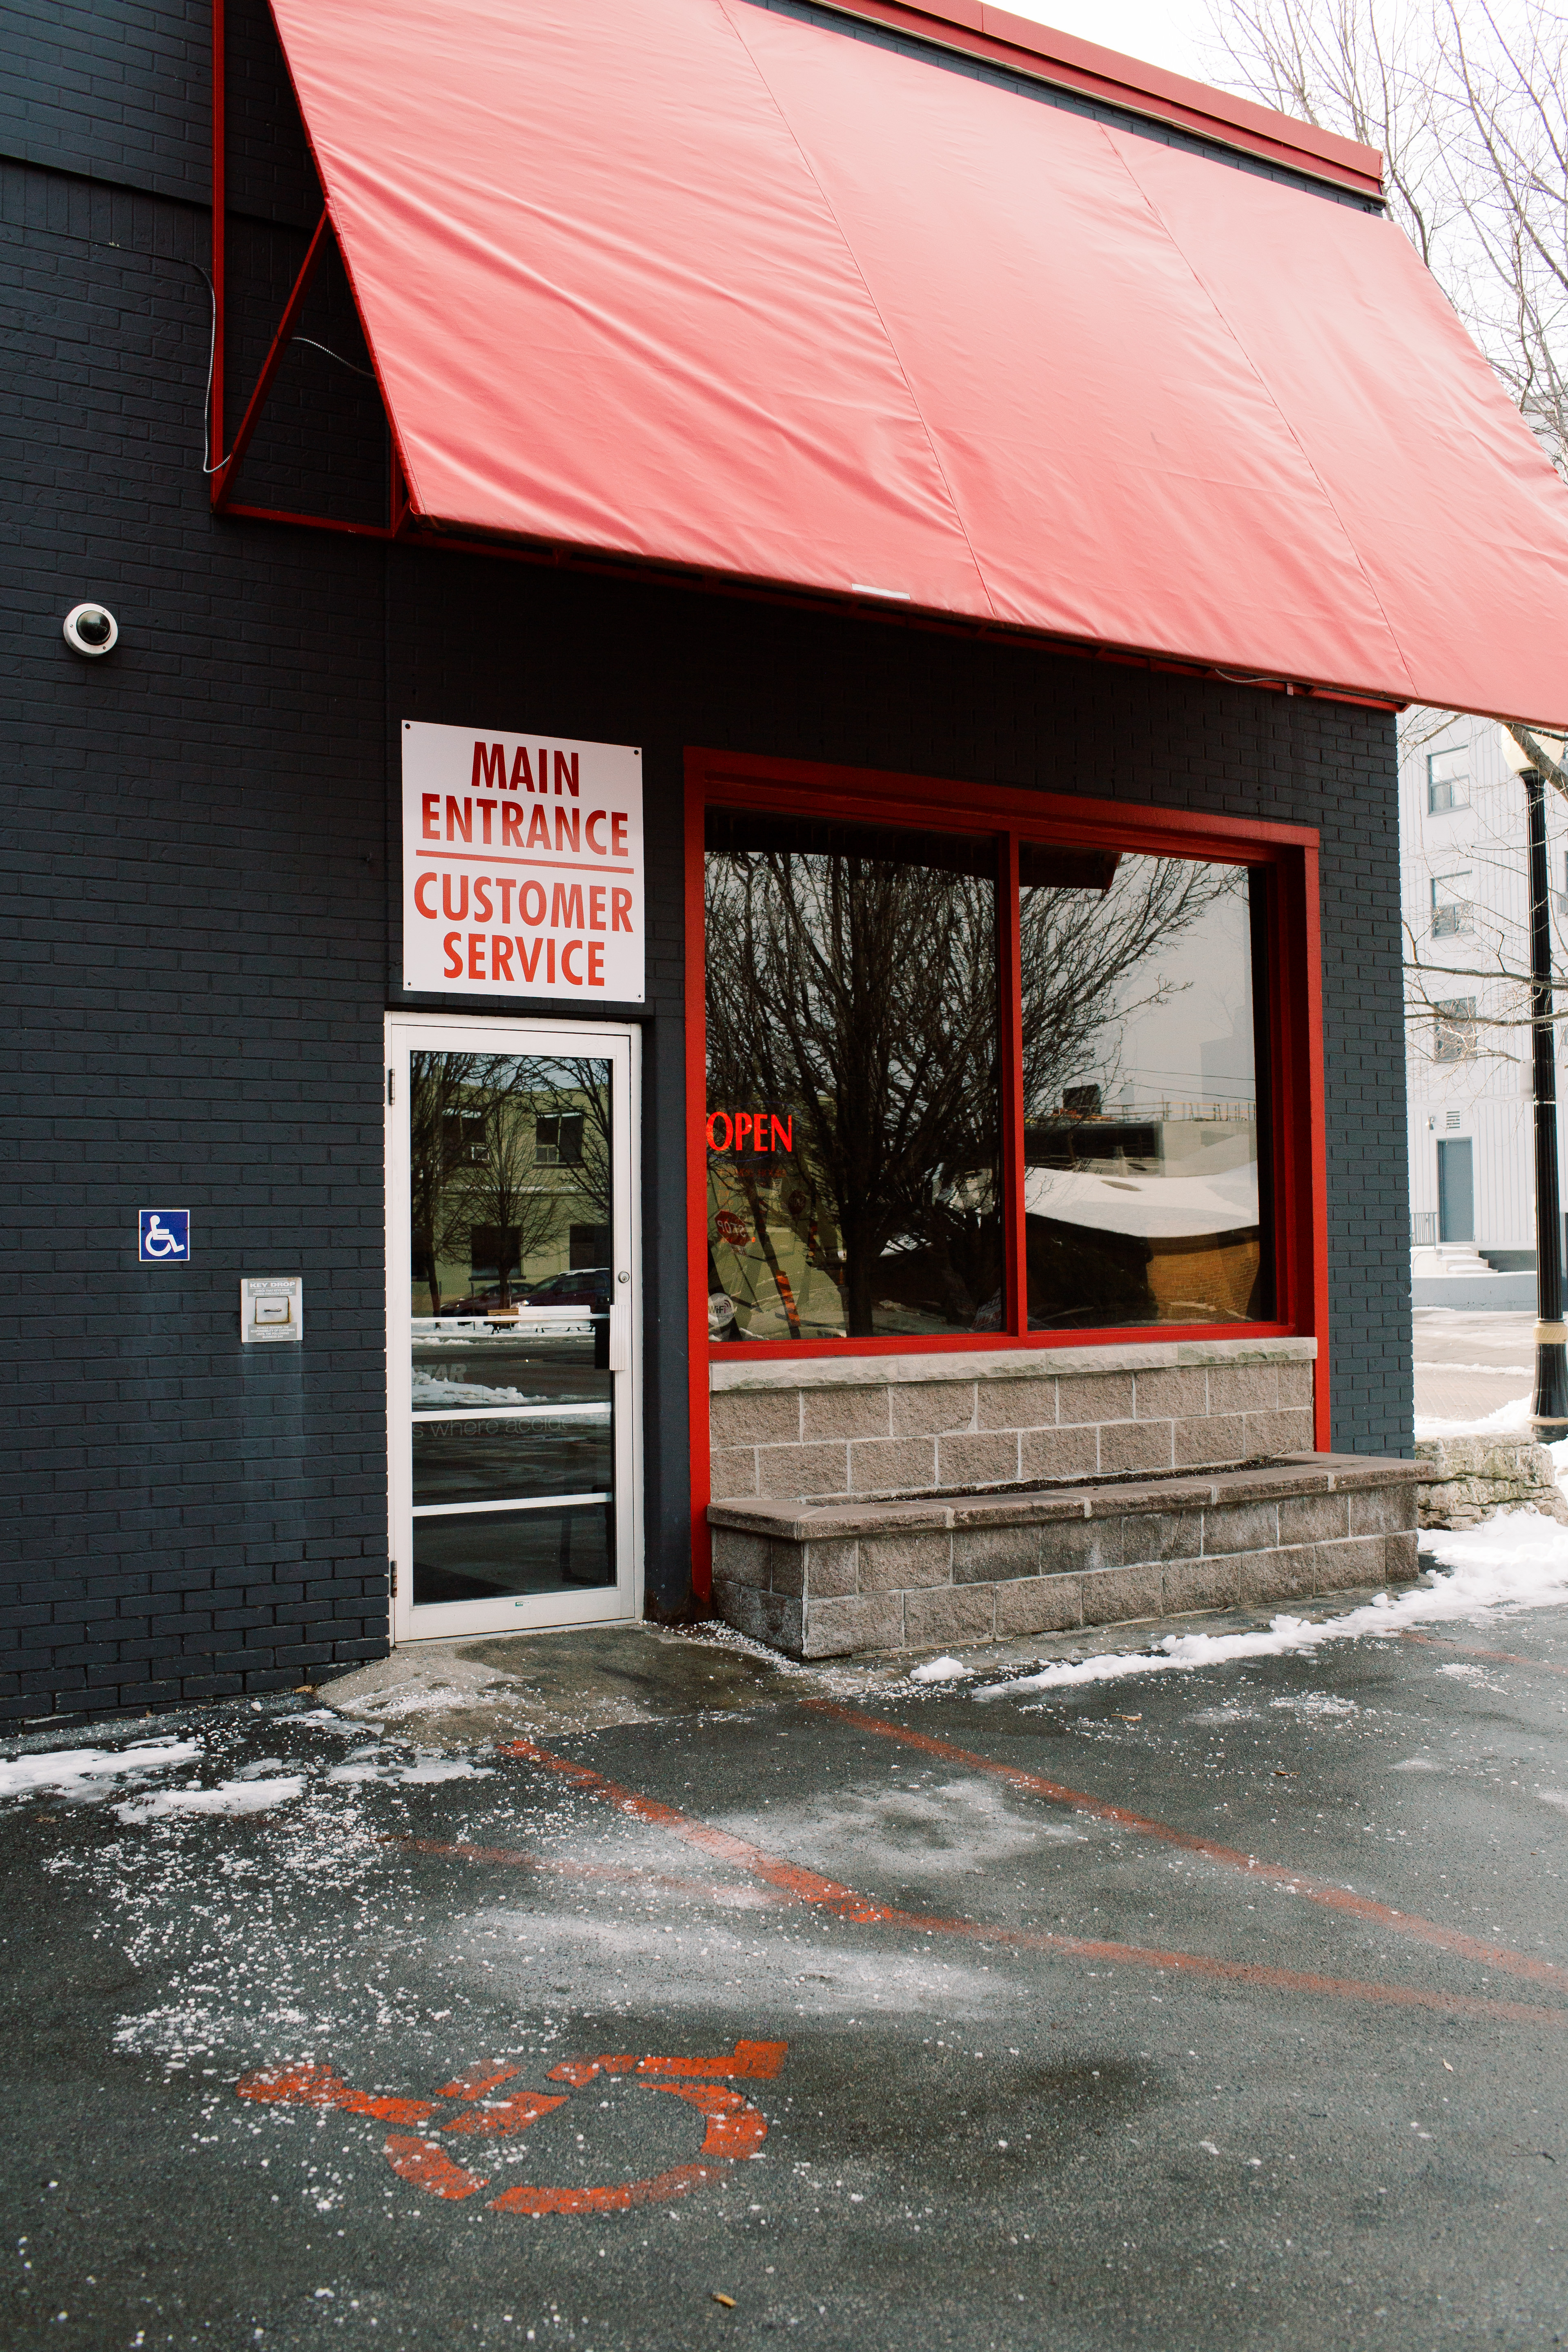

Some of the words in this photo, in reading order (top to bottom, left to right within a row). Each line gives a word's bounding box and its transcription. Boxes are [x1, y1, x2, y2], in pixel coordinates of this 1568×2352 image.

[471, 741, 579, 797] MAIN
[422, 793, 628, 857] ENTRANCE
[414, 872, 634, 933] CUSTOMER
[443, 932, 605, 987] SERVICE
[706, 1111, 792, 1152] OPEN
[430, 1420, 499, 1437] where
